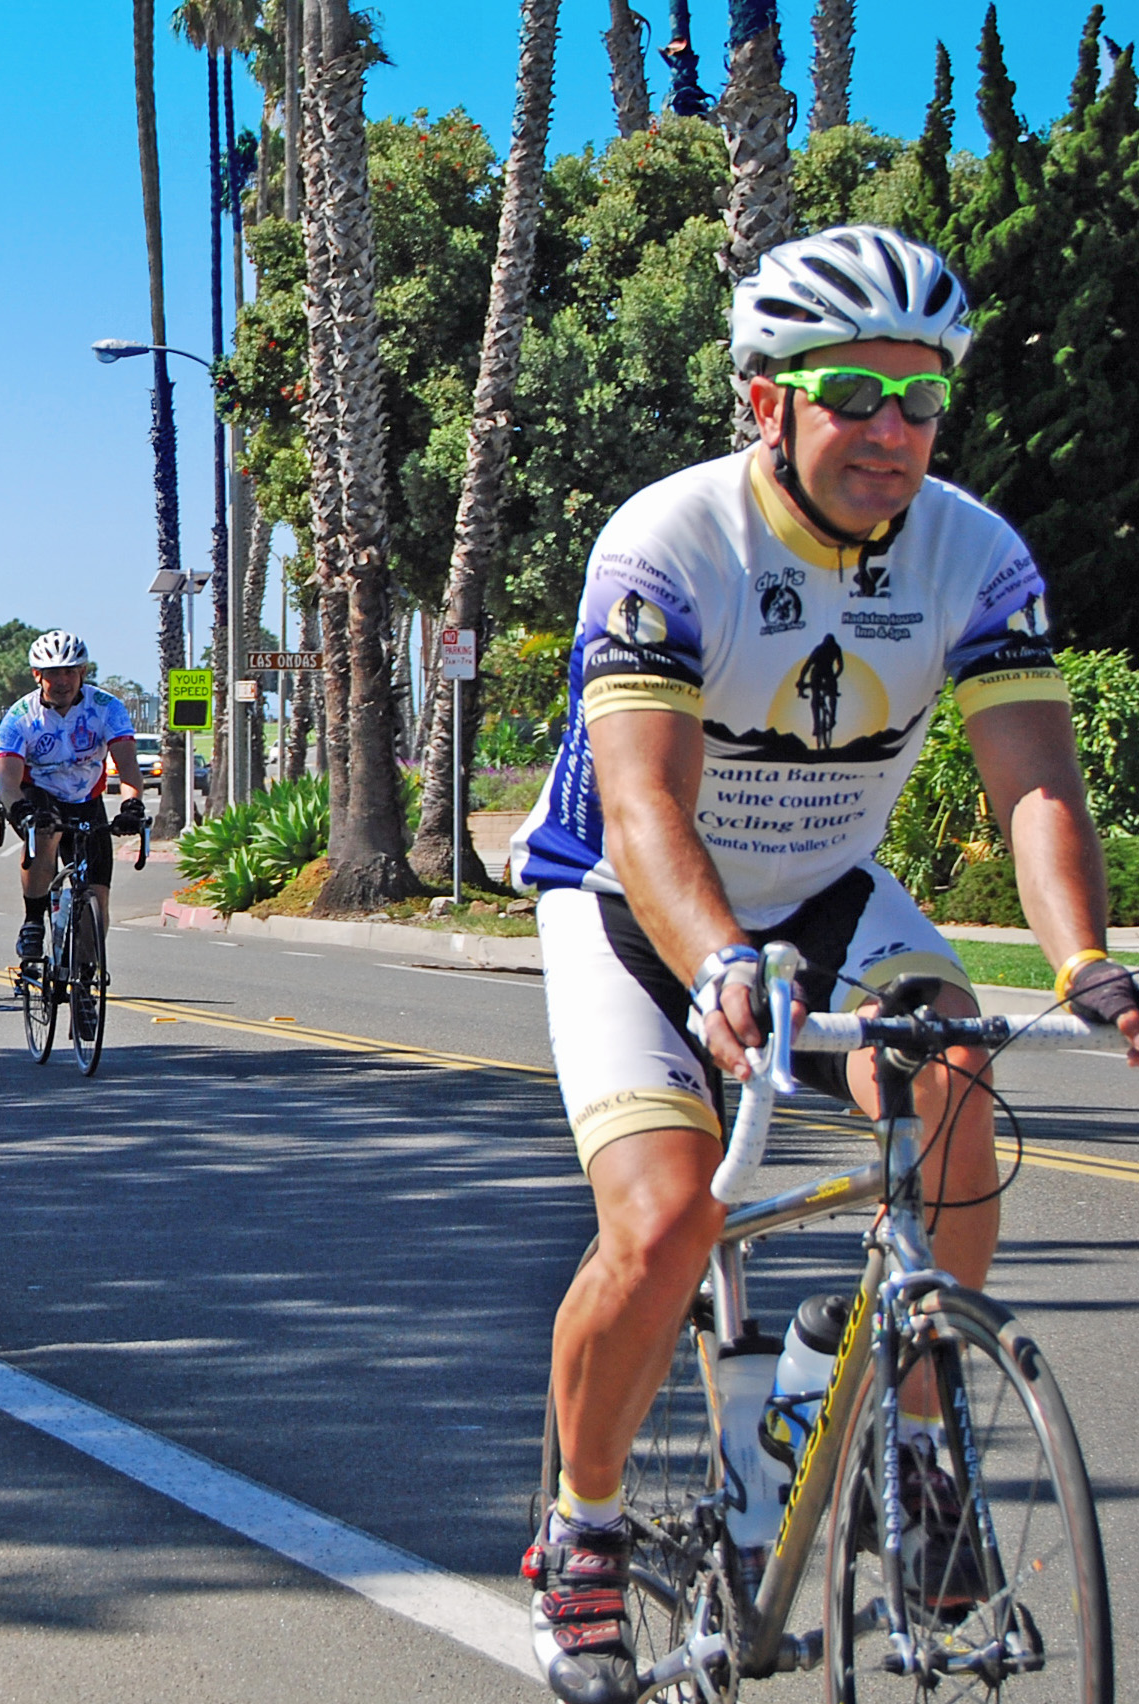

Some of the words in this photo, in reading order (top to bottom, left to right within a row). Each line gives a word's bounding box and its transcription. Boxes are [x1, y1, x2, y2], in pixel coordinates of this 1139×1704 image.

[445, 632, 456, 643] NO
[445, 646, 472, 655] PARKING
[250, 655, 272, 668] LAS
[277, 654, 317, 668] ONDAS
[176, 675, 206, 684] YOUR
[173, 687, 209, 696] SPEED
[704, 767, 780, 782] Santa
[717, 790, 774, 807] wine
[779, 790, 864, 808] country
[698, 810, 794, 833] Cycling
[799, 808, 866, 830] Tours
[705, 833, 748, 850] Santa
[752, 841, 786, 853] Ynez
[616, 1091, 637, 1104] CA
